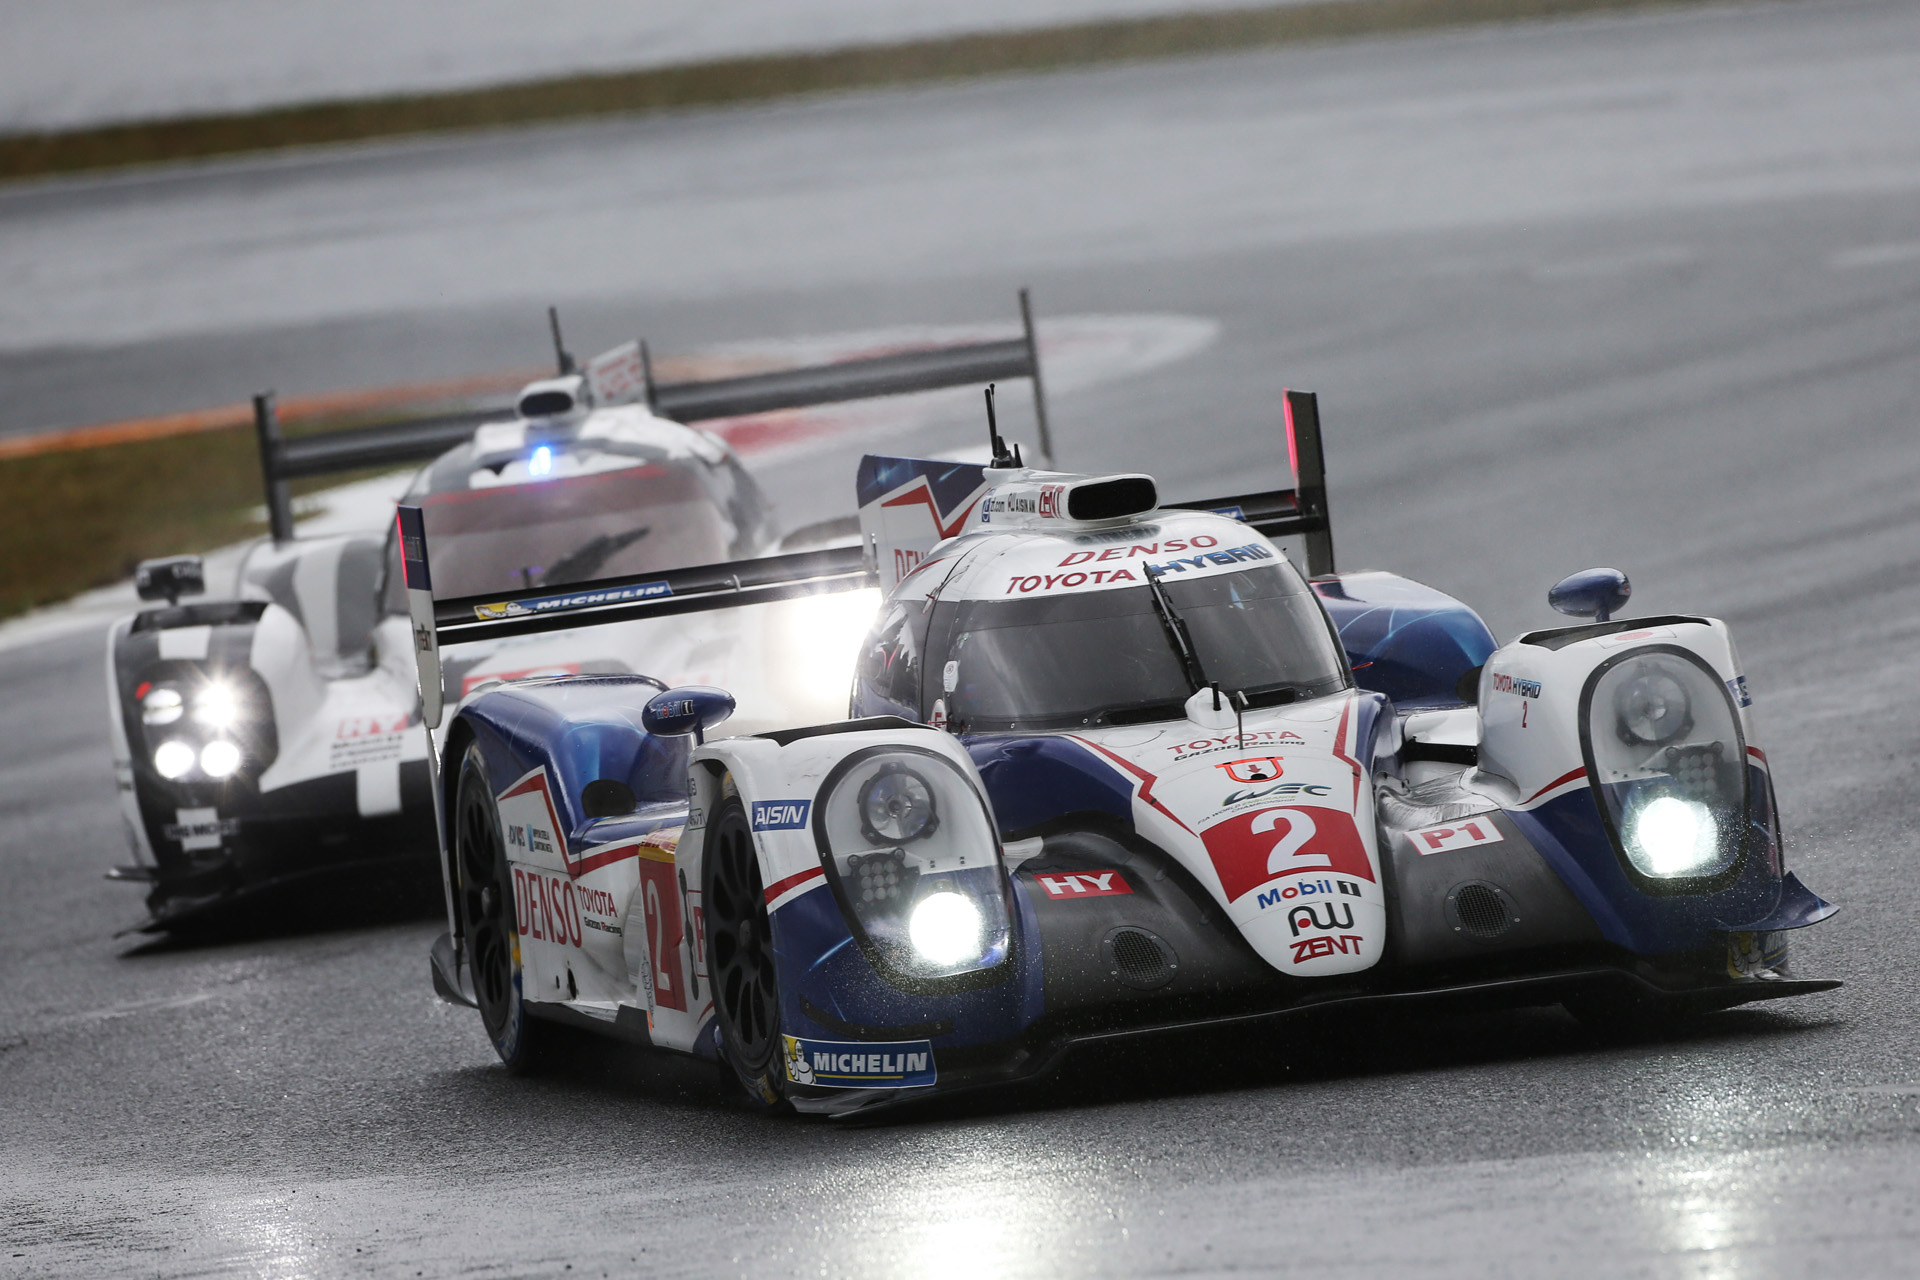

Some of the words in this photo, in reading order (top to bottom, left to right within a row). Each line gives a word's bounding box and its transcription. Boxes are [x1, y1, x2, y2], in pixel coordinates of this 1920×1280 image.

[1057, 535, 1219, 568] DENSO
[1006, 569, 1137, 594] TOYOTA
[1149, 543, 1275, 577] HYBRID
[536, 584, 666, 611] MICHELIN
[1493, 673, 1512, 693] TOYOTA
[1512, 677, 1542, 699] HYBRID
[656, 701, 682, 719] Mobil
[1522, 700, 1528, 729] 2
[1167, 730, 1302, 754] TOYOTA
[1212, 803, 1241, 817] WORLD
[1242, 795, 1297, 806] ENDURANCE
[1222, 782, 1333, 807] WEC
[1231, 798, 1296, 813] CHAMPIONSHIP
[755, 805, 805, 825] AISIN
[1250, 808, 1333, 876] 2
[1420, 823, 1487, 849] P1
[1040, 873, 1114, 895] HY
[1257, 879, 1333, 910] Mobil
[514, 868, 583, 948] DENSO
[577, 885, 618, 918] TOYOTA
[646, 878, 671, 991] 2
[1289, 934, 1364, 965] ZENT
[814, 1051, 928, 1074] MICHELIN
